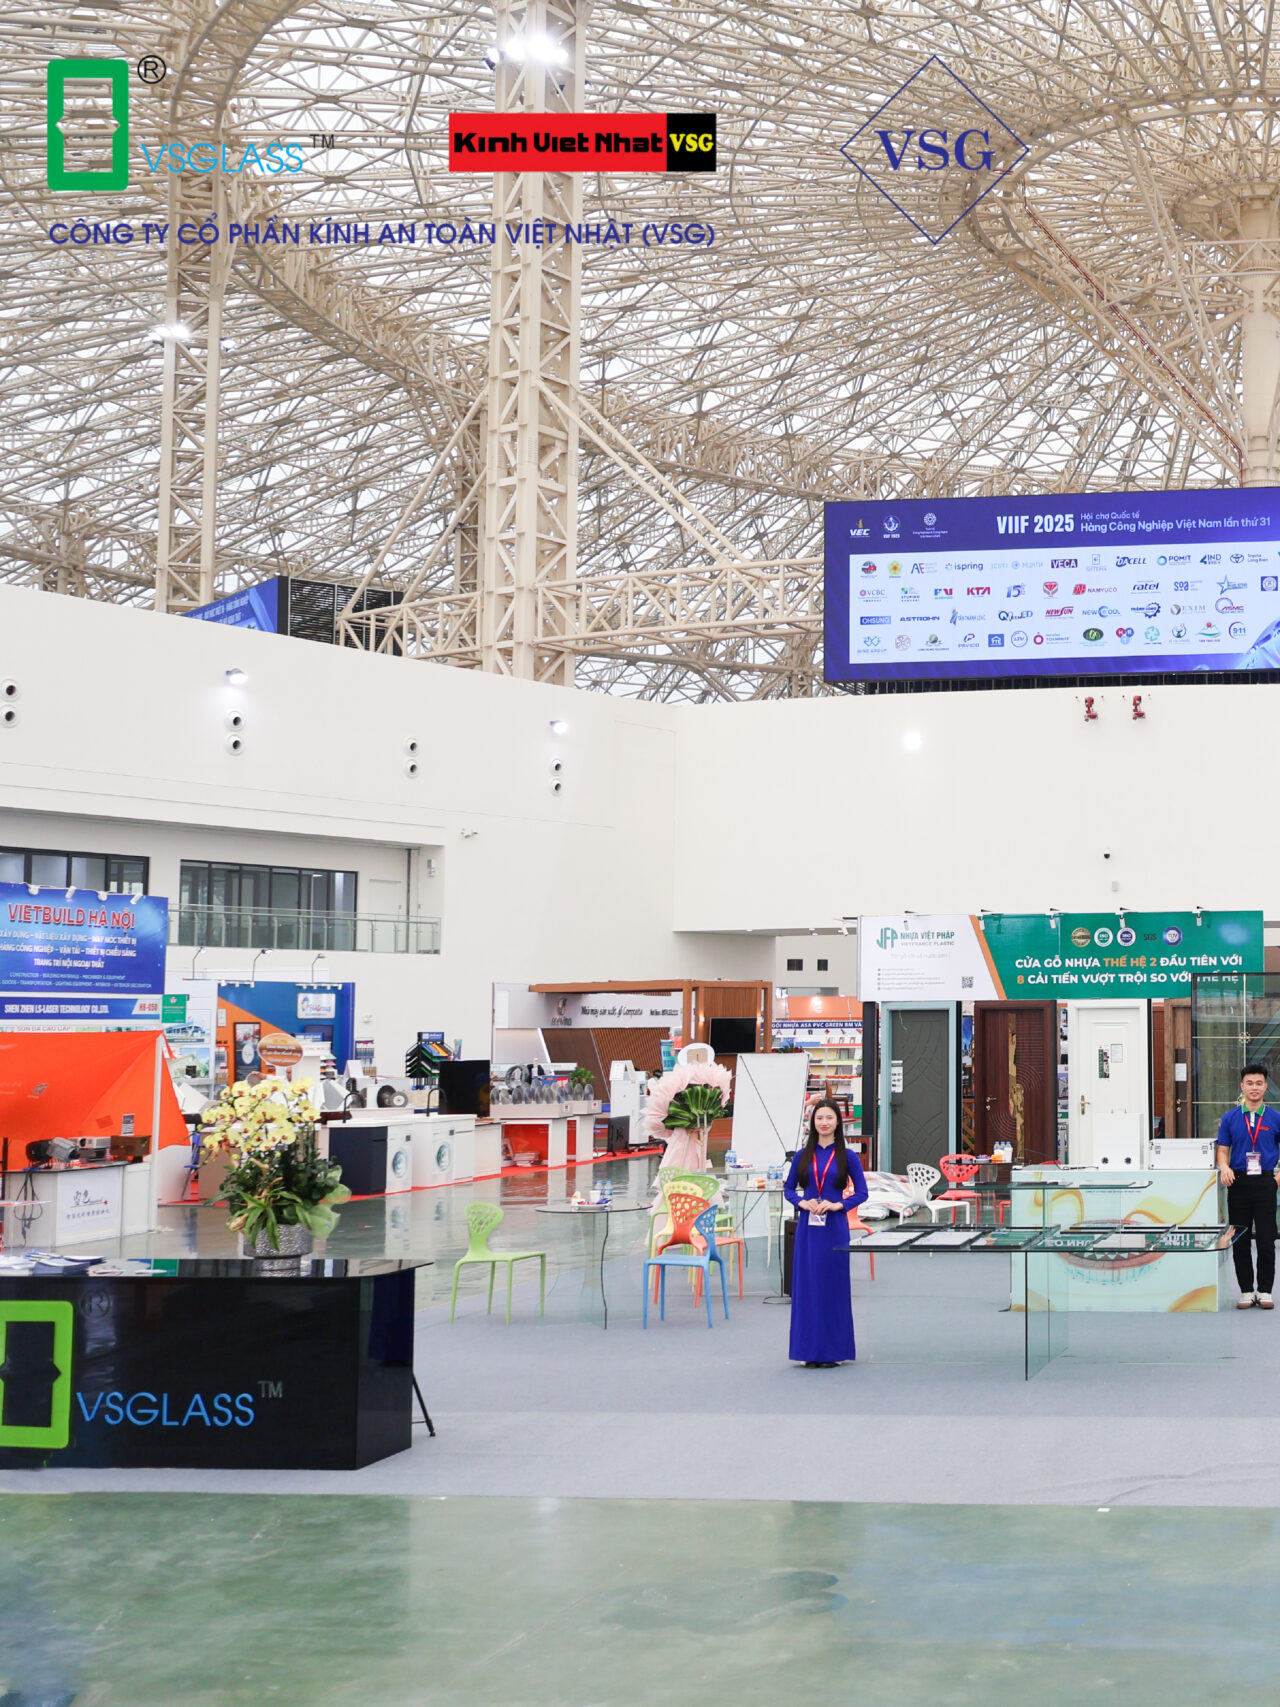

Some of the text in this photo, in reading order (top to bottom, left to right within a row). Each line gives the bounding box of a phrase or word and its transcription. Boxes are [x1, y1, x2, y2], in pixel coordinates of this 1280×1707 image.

[1080, 513, 1093, 521] Hội
[1111, 511, 1130, 519] Quốc
[1132, 510, 1140, 519] tế
[996, 514, 1074, 534] VIIF 2025
[1080, 516, 1271, 534] Hàng Công Nghiệp Việt Nam lần thứ 31
[850, 528, 870, 536] VEC
[955, 562, 983, 571] ispring
[1052, 559, 1078, 568] VECA
[1132, 582, 1160, 591] ratel
[8, 904, 135, 934] VIETBUILD HÀ NỘI
[900, 931, 955, 941] NHỰA VIỆT PHÁP
[1015, 954, 1243, 969] CỬA GỖ NHỰA THẾ HỆ 2 ĐẦU TIÊN VỚI
[1017, 971, 1191, 986] 8 CẢI TIẾN VƯỢT TRỘI SO VỚI
[76, 1381, 283, 1427] VSGLASS TM
